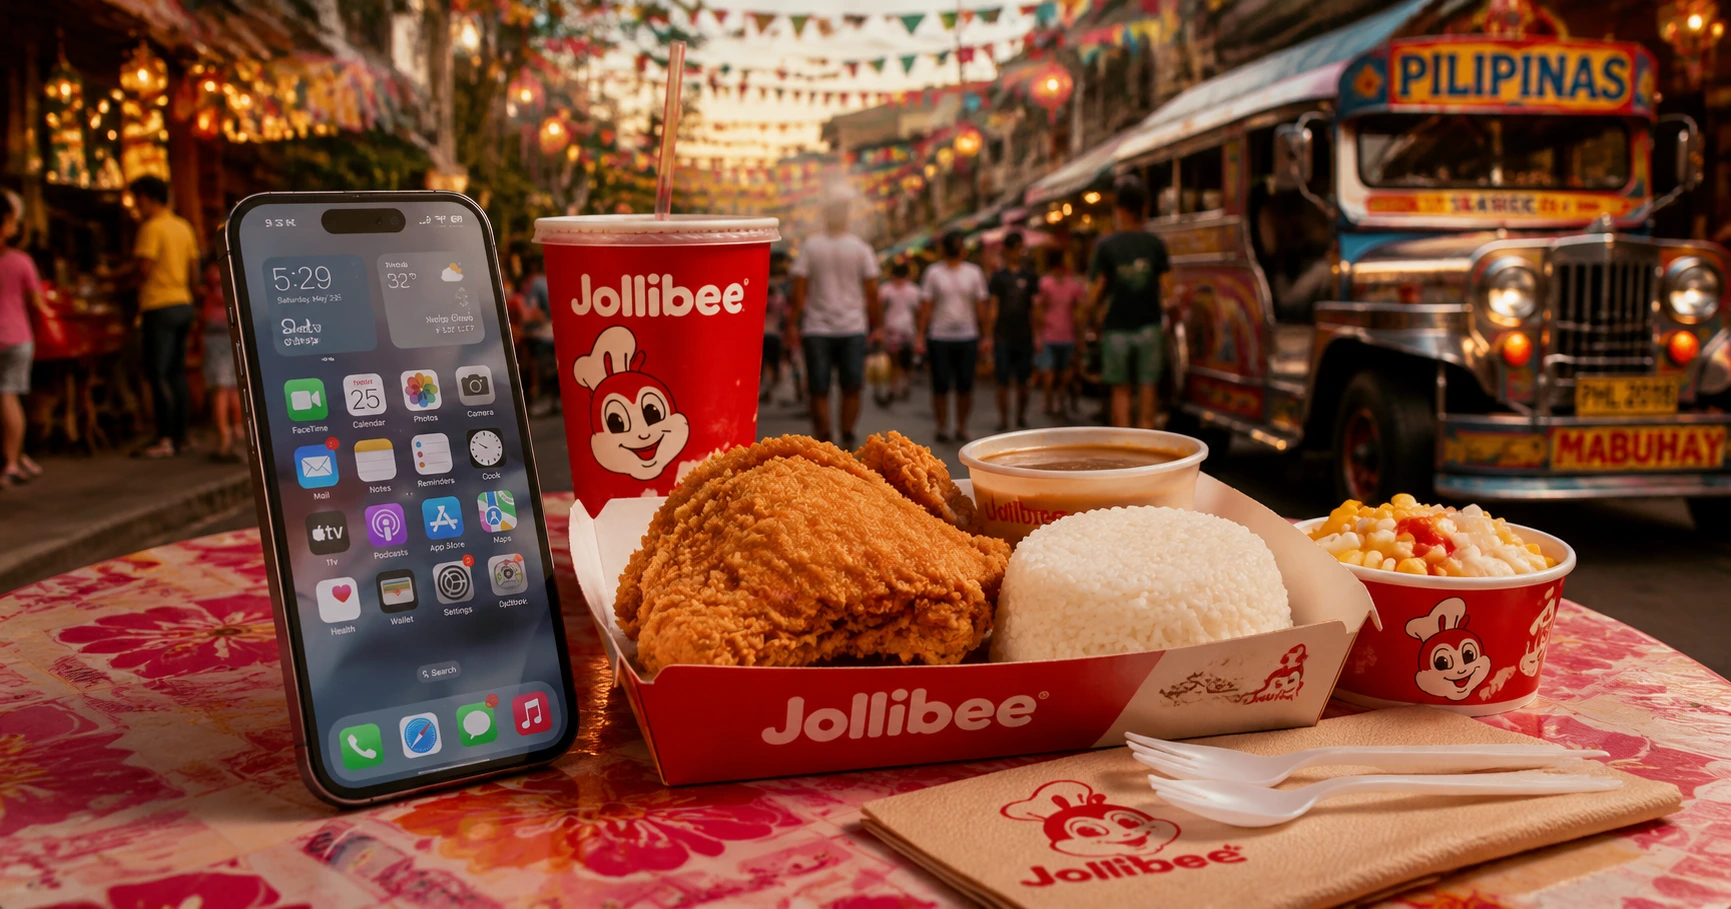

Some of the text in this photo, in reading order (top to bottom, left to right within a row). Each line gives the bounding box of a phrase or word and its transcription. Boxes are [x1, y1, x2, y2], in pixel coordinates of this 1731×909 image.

[1401, 53, 1628, 99] PILIPINAS
[272, 265, 332, 292] 5:29
[571, 273, 745, 317] Jollibee
[351, 388, 380, 410] 25
[467, 409, 494, 418] Camera
[352, 419, 386, 429] Calendar
[413, 415, 438, 423] Photos
[292, 425, 328, 434] FaceTime
[1556, 429, 1726, 466] MABUHAY
[417, 477, 456, 487] Reminders
[369, 485, 392, 493] Notes
[313, 492, 330, 500] Mail
[325, 525, 343, 540] tv
[430, 544, 445, 553] App
[443, 606, 473, 616] Settings
[390, 615, 414, 625] Wallet
[330, 624, 356, 636] Health
[431, 666, 457, 677] Search
[761, 688, 1037, 745] Jollibee
[1020, 849, 1248, 888] Jollibee
